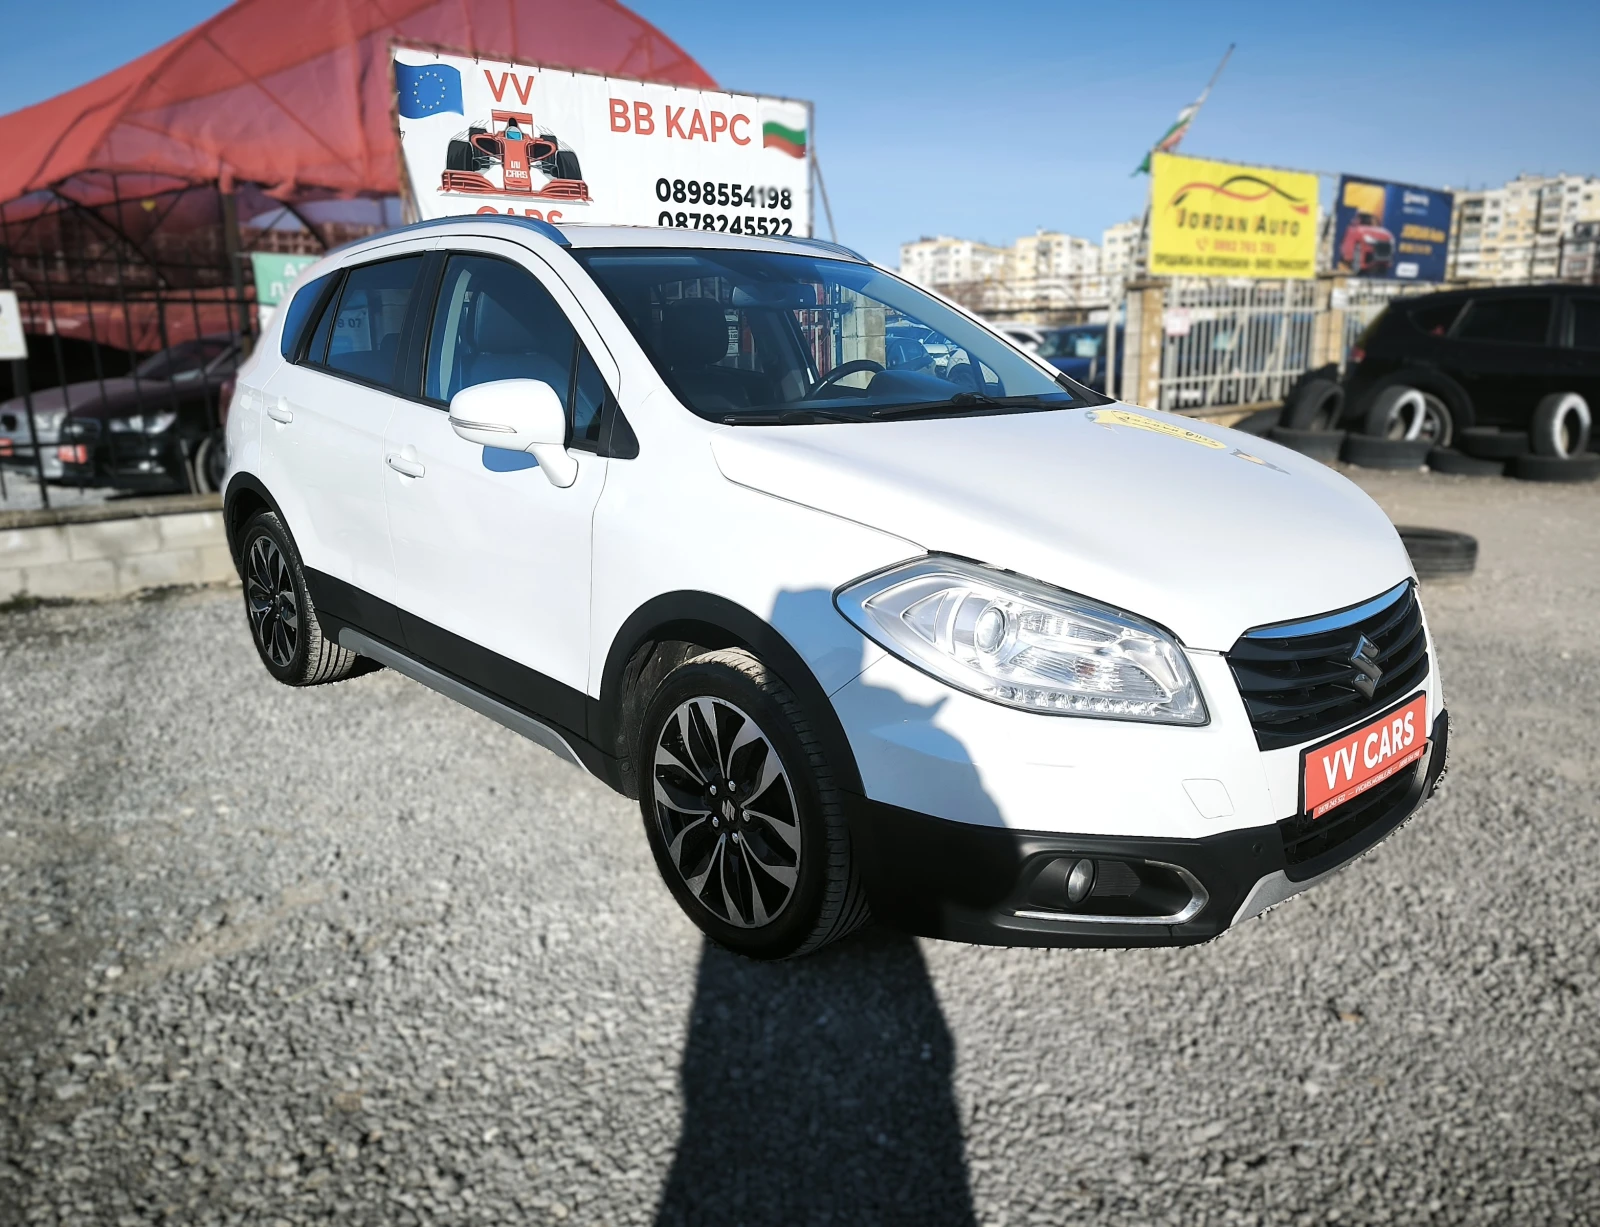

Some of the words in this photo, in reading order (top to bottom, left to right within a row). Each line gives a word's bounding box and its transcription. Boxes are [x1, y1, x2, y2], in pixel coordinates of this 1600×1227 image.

[483, 69, 535, 105] VV
[608, 97, 655, 136] ВВ
[666, 104, 751, 146] КАРС
[656, 177, 792, 210] 0898554198
[658, 210, 792, 236] 0878245522
[1322, 741, 1358, 790] VV
[1363, 711, 1415, 769] CARS
